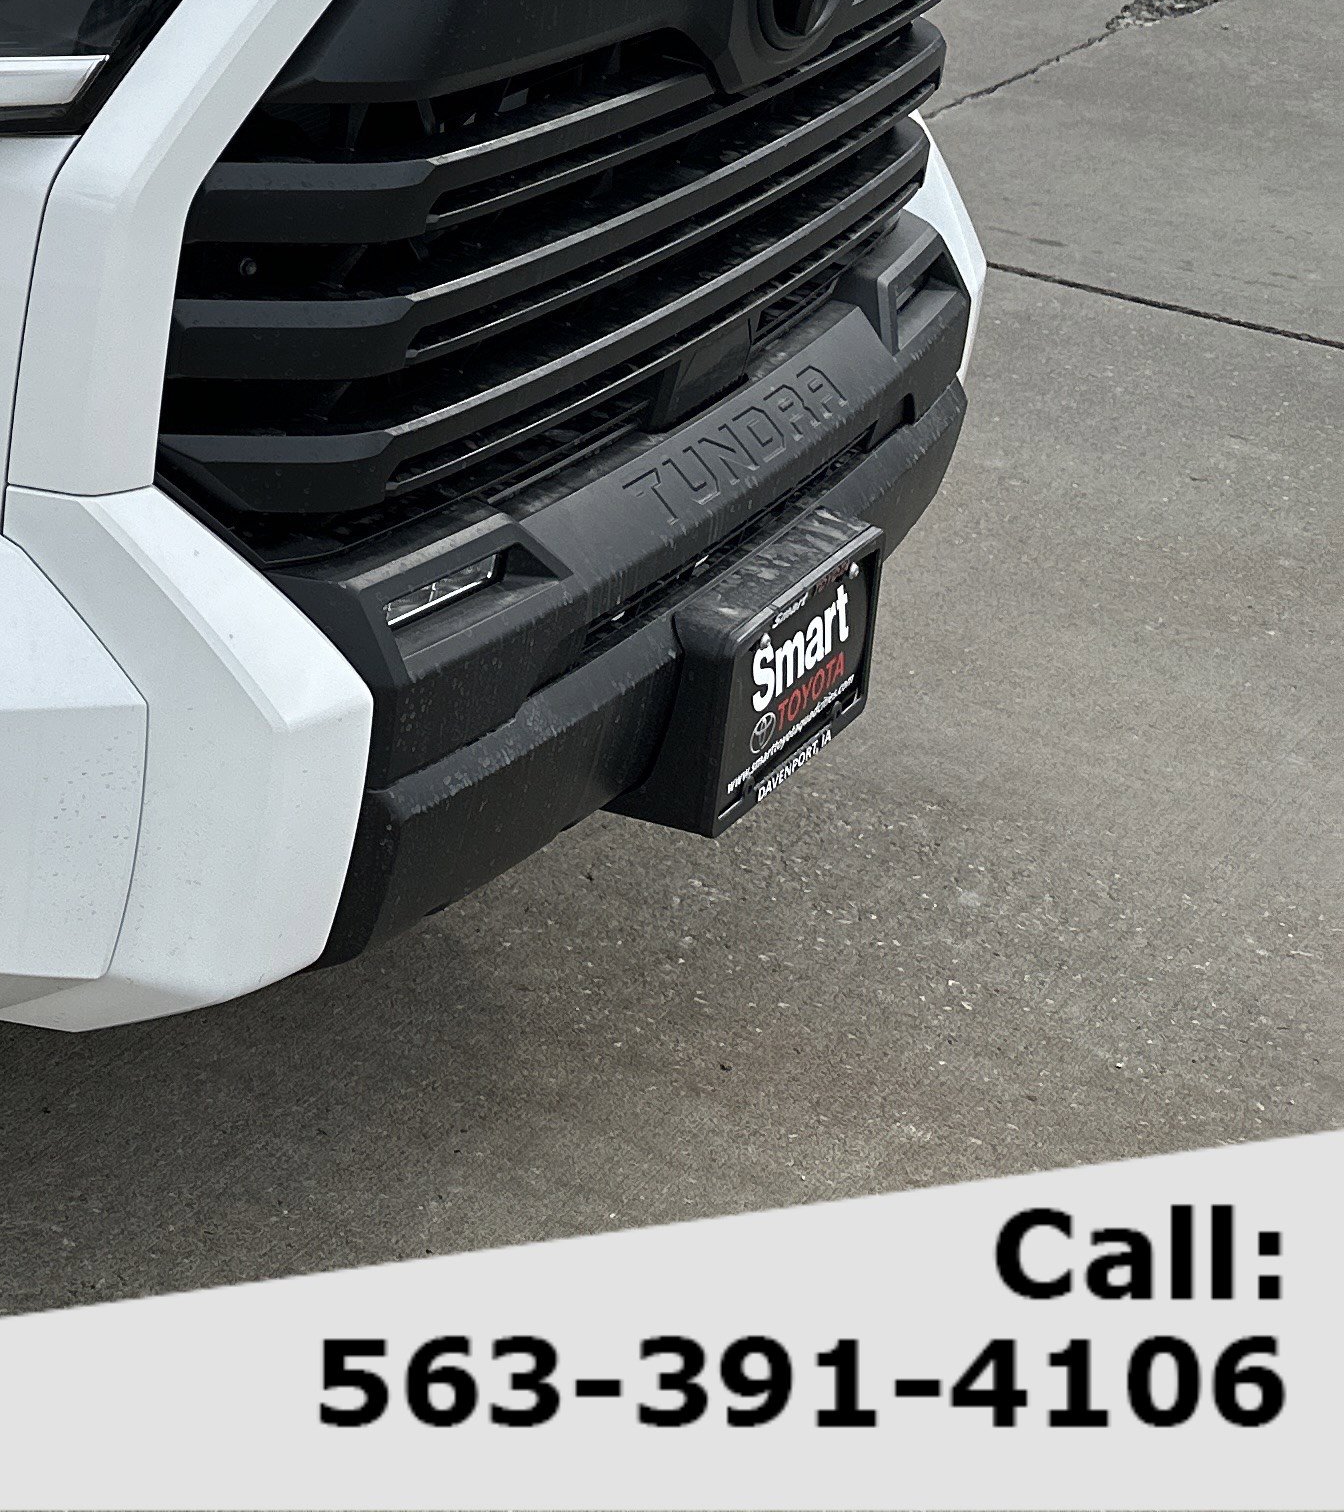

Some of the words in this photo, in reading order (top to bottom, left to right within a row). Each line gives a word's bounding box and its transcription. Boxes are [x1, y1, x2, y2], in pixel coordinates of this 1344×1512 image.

[621, 364, 850, 528] TUNDRA
[752, 584, 850, 713] Smart
[777, 651, 846, 731] TOYOTA
[757, 739, 820, 802] DAVENPORT,
[819, 728, 833, 749] IA
